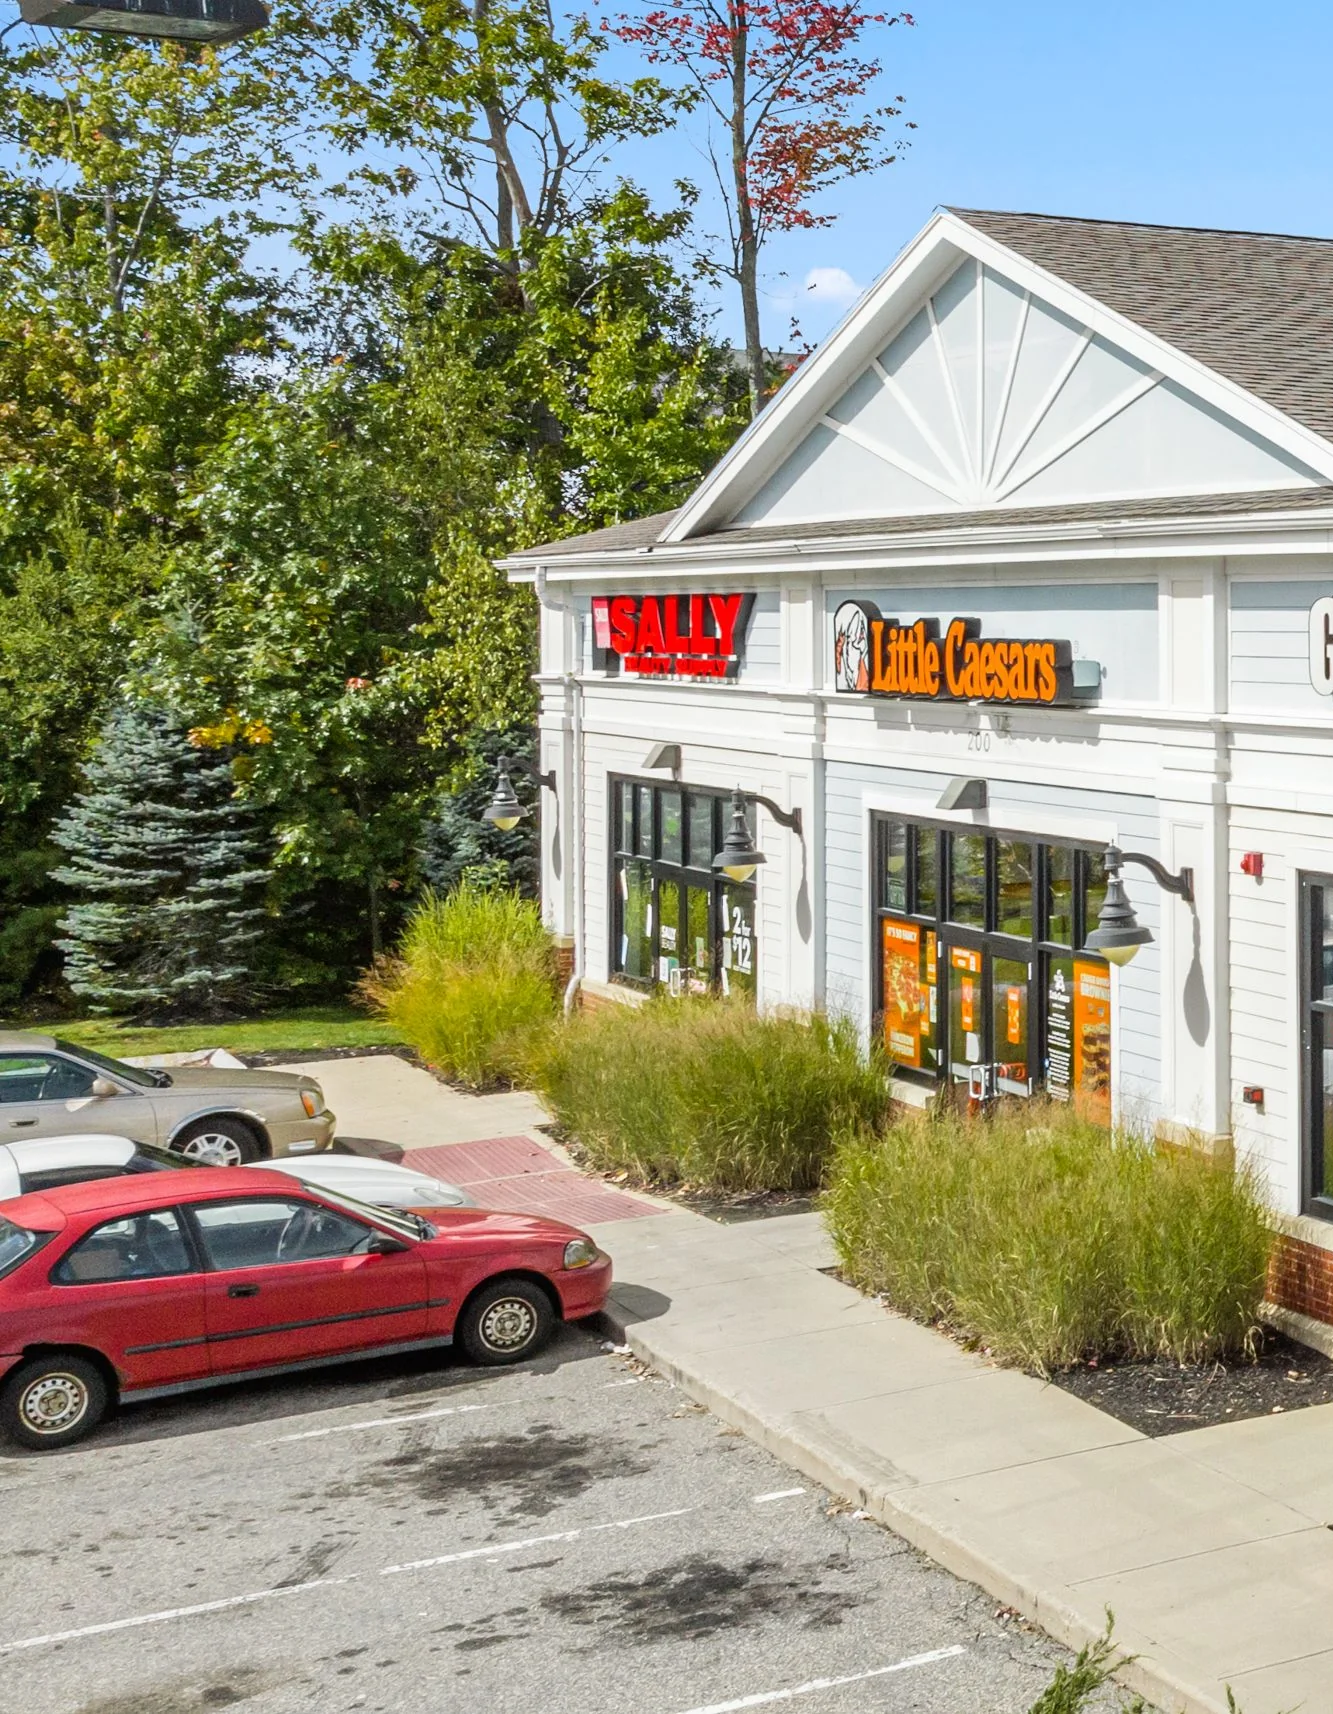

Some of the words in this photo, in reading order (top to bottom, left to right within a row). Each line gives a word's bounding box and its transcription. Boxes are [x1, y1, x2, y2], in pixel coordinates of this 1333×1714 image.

[611, 593, 743, 657] SALLY
[871, 620, 941, 696] Little
[944, 618, 1058, 704] Caesars
[967, 731, 991, 752] 200
[733, 906, 742, 934] 2
[733, 934, 752, 969] $12
